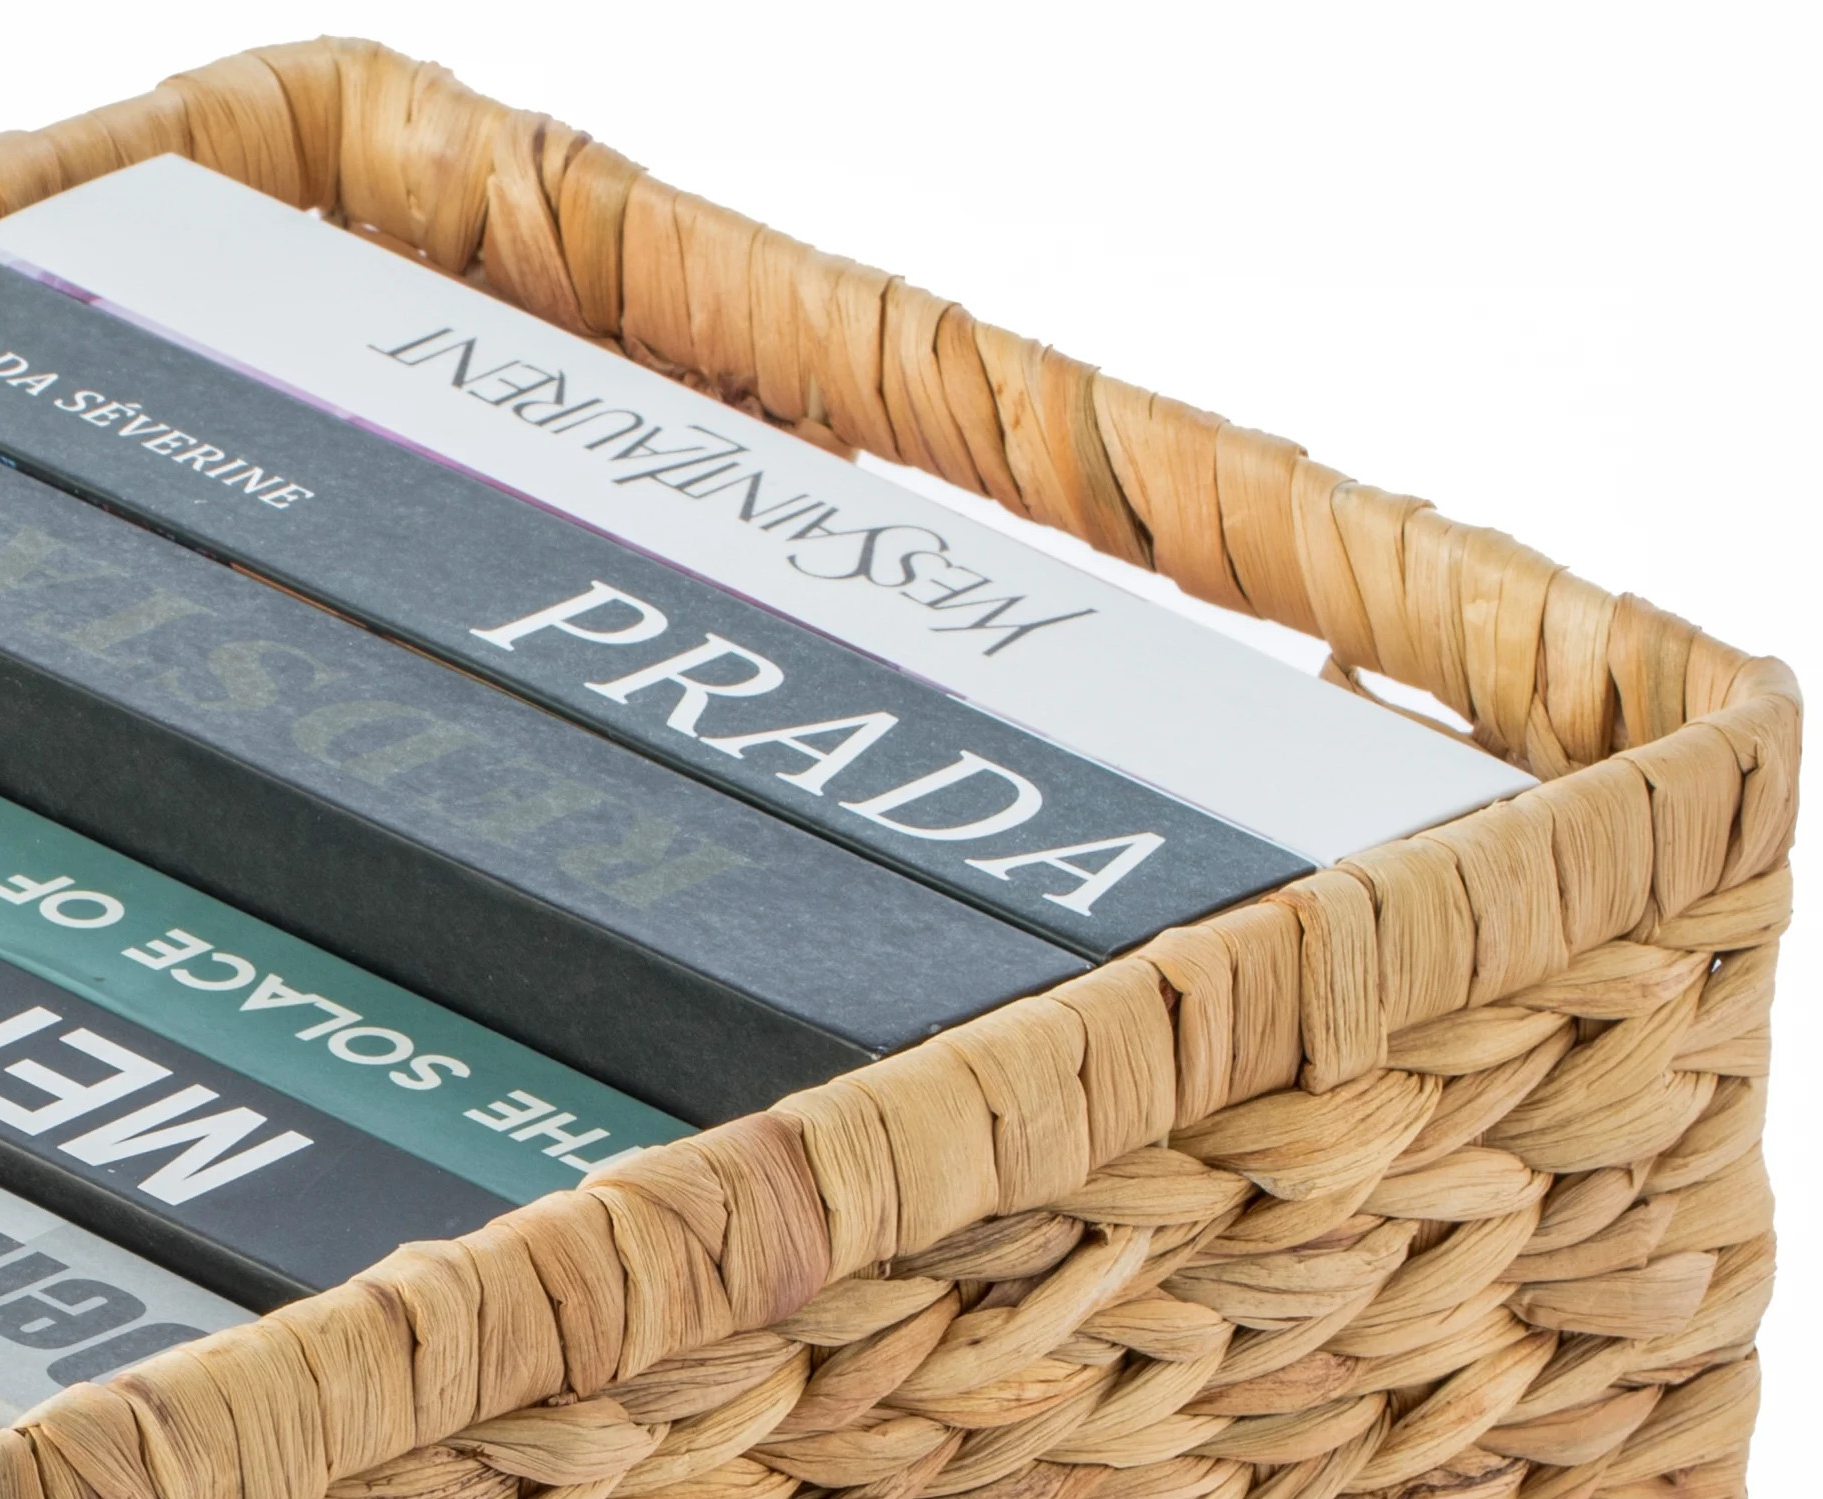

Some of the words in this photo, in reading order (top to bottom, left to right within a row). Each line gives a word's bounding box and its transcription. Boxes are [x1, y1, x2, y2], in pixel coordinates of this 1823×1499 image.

[54, 391, 315, 510] SÉVERINE
[469, 580, 1165, 917] PRADA
[120, 929, 471, 1090] SOLACE
